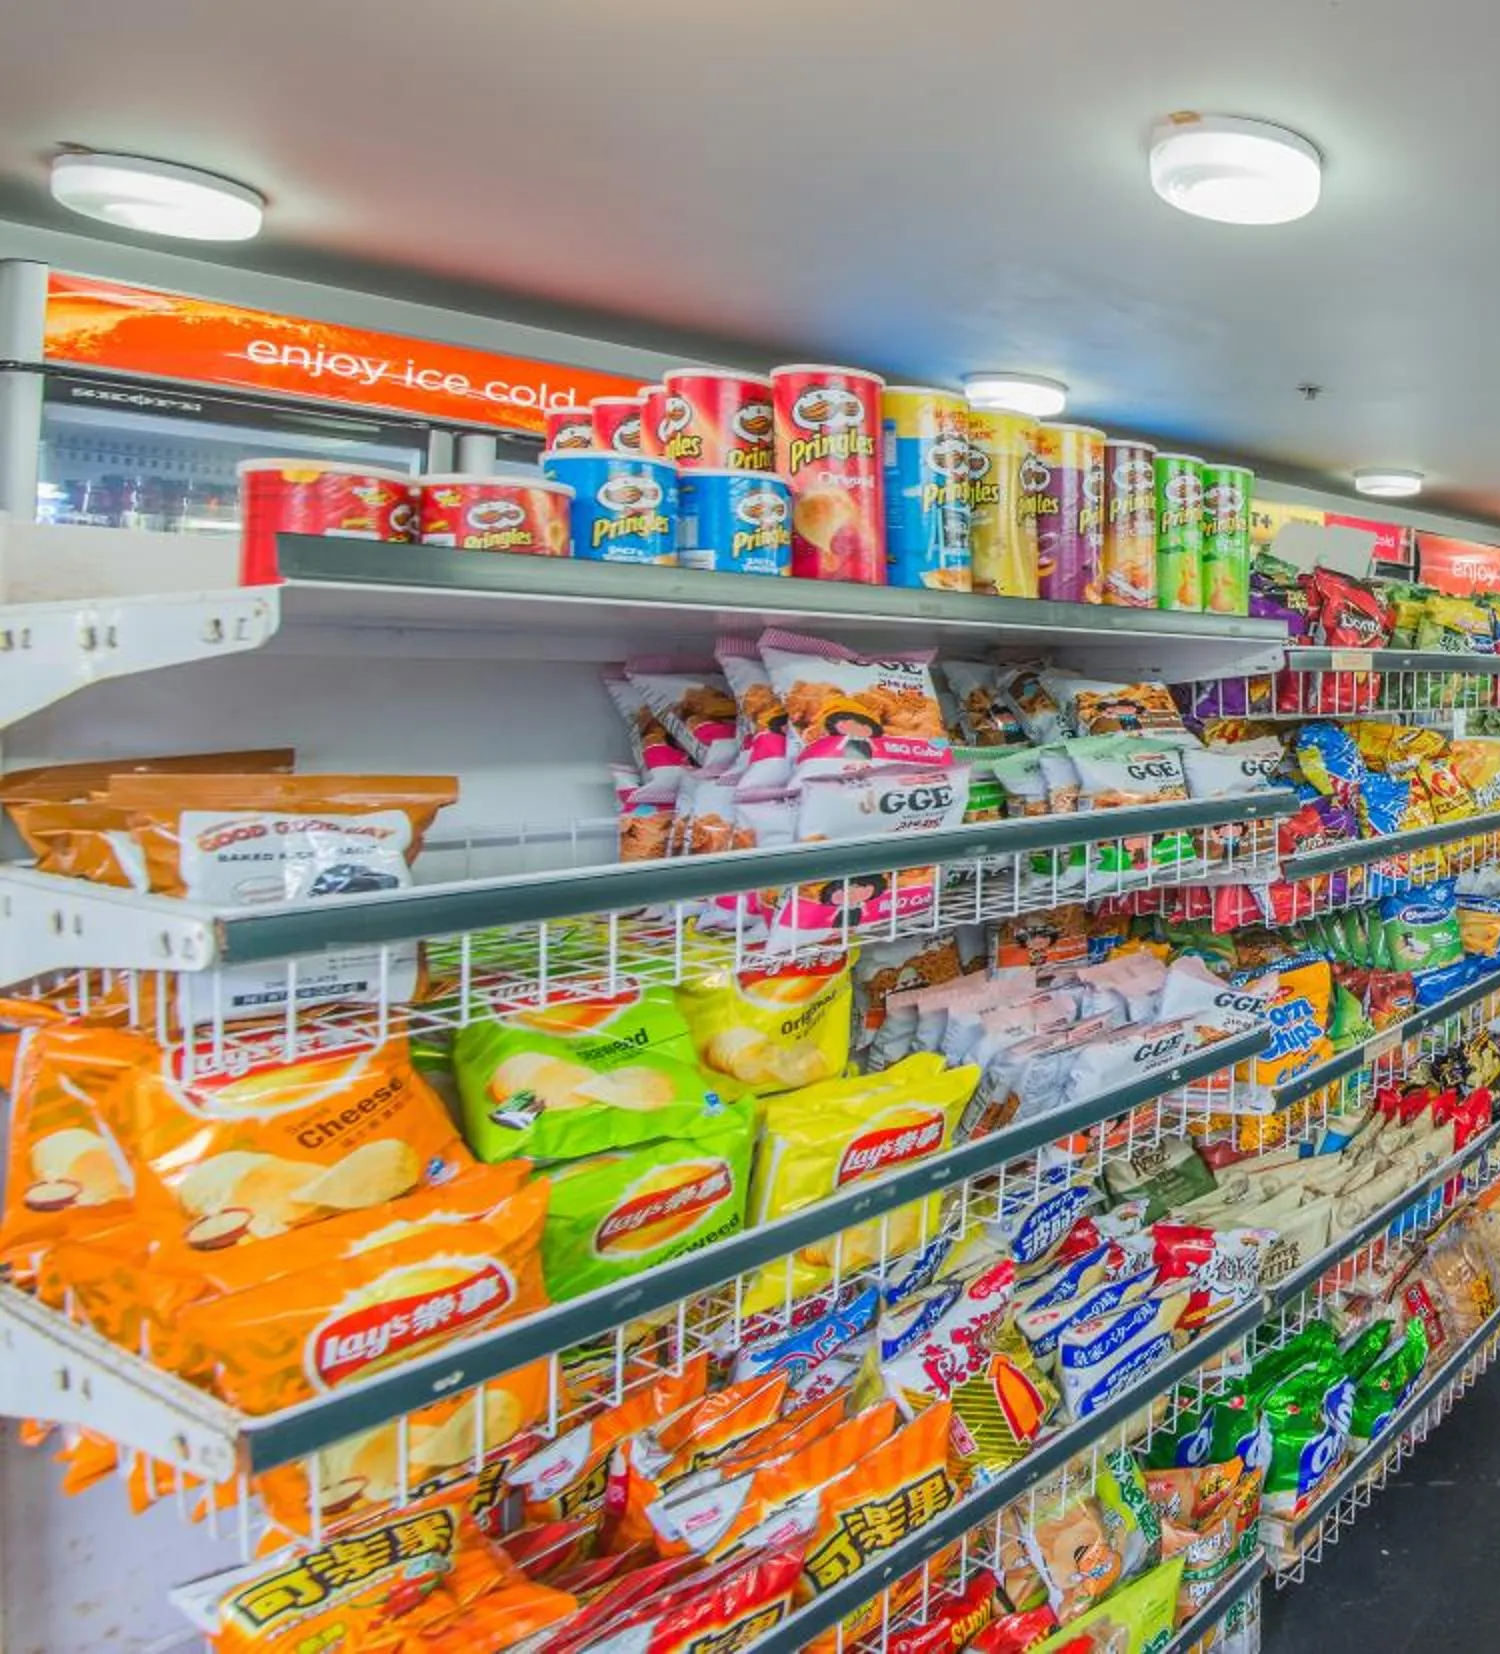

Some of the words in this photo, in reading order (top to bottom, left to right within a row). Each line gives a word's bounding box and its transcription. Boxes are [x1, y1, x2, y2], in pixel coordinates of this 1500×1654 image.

[246, 334, 390, 386] enjoy
[404, 360, 471, 394] ice
[484, 379, 577, 409] cold
[790, 430, 874, 475] Pringles
[462, 528, 533, 550] Pringles
[592, 514, 669, 548] Pringles
[1451, 560, 1498, 585] enjoy
[1127, 761, 1180, 780] GGE
[879, 785, 953, 815] GGE
[298, 1077, 403, 1149] Cheese
